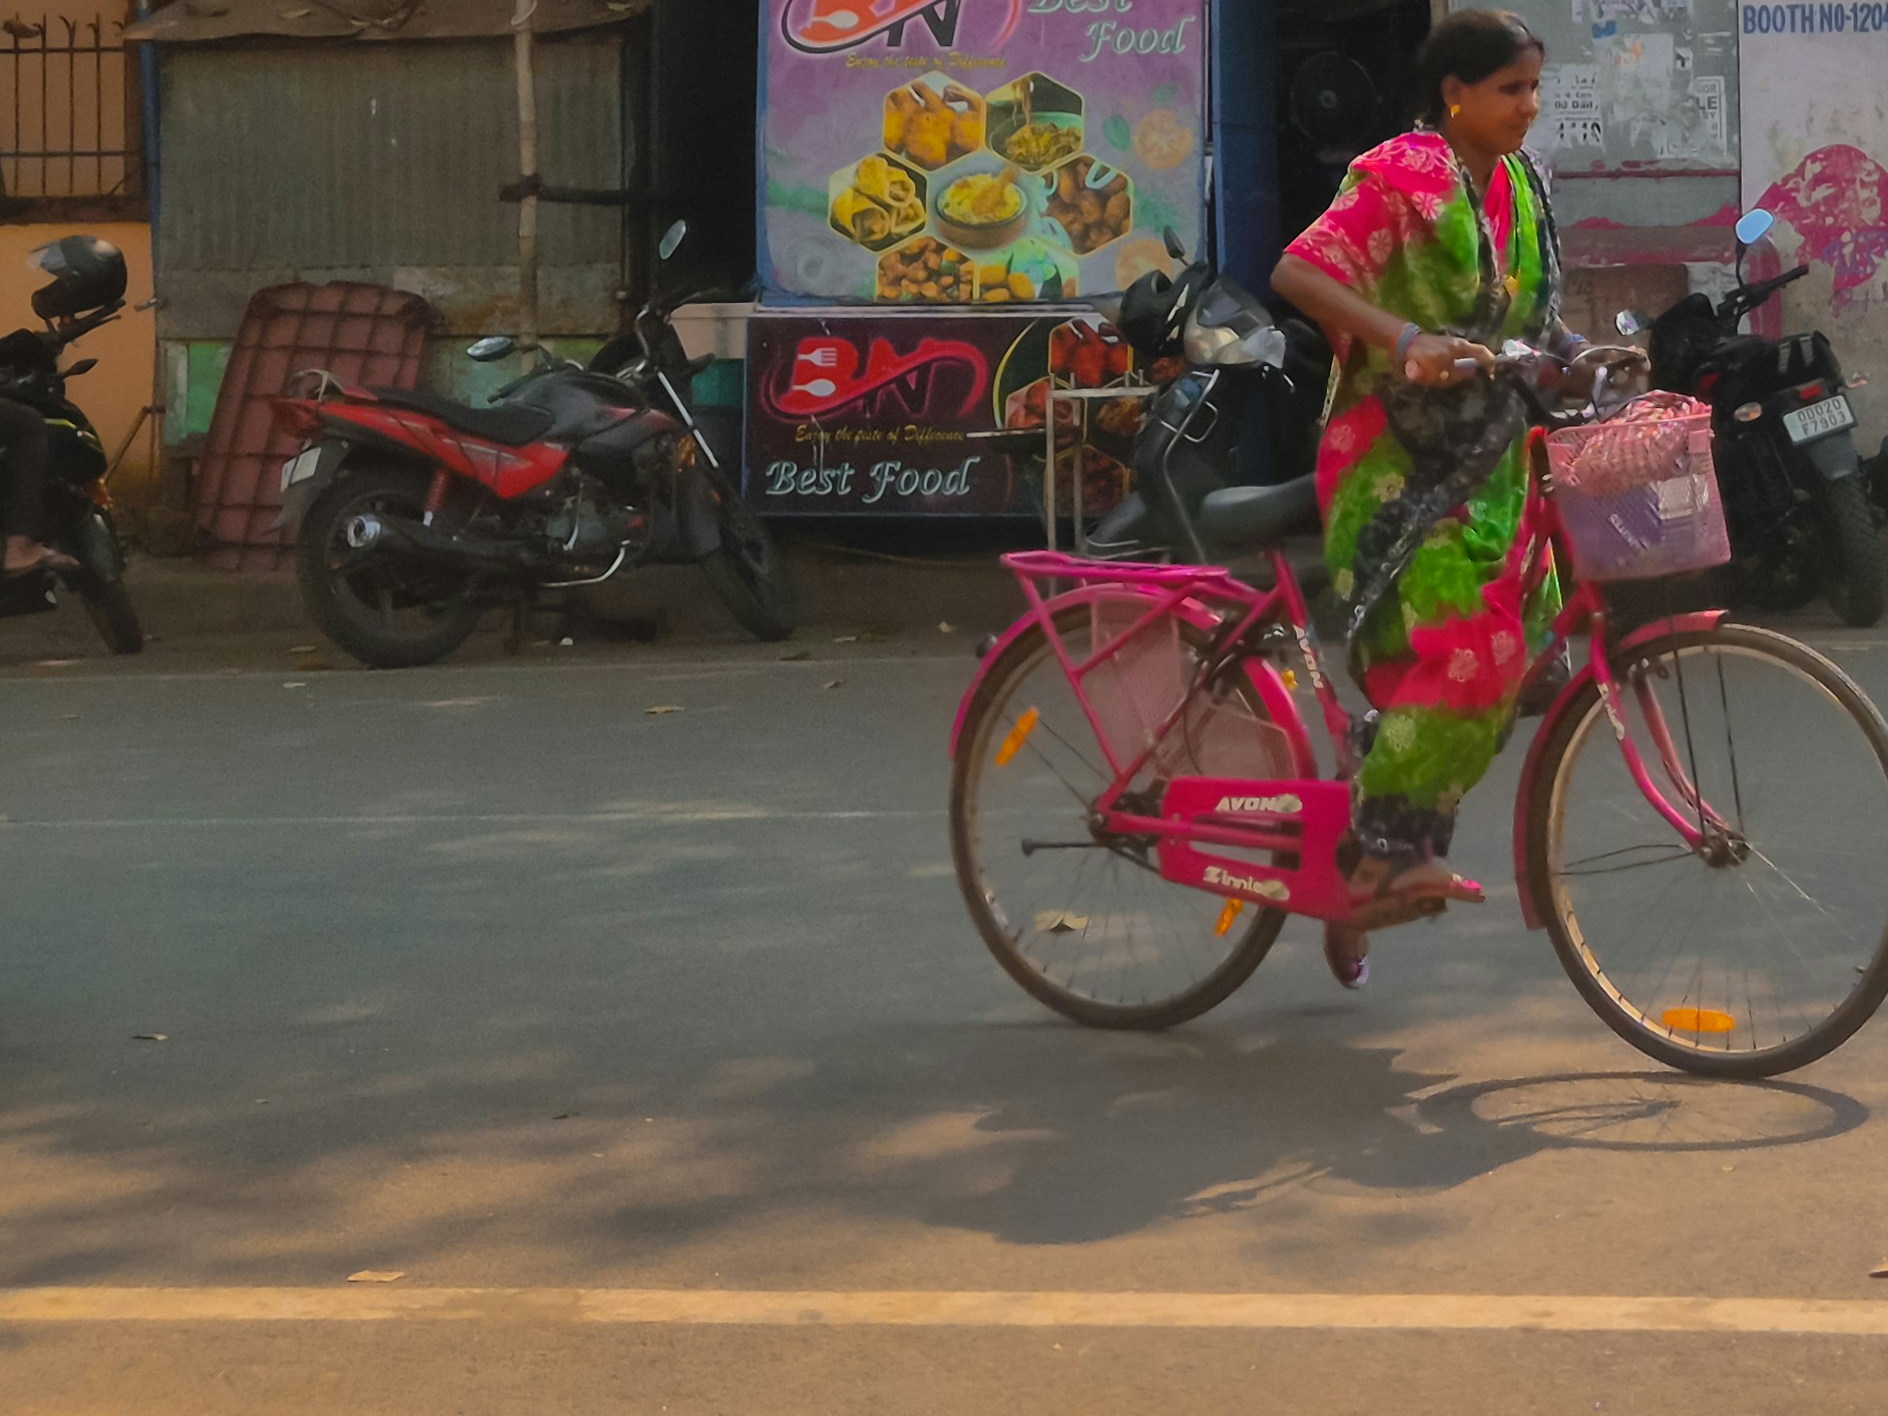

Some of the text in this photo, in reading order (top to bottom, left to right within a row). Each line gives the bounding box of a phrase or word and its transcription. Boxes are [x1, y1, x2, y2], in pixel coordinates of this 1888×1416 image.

[1742, 4, 1815, 34] BOOTH
[1078, 15, 1197, 63] Food
[765, 456, 981, 504] Best Food
[1215, 796, 1279, 812] AVON
